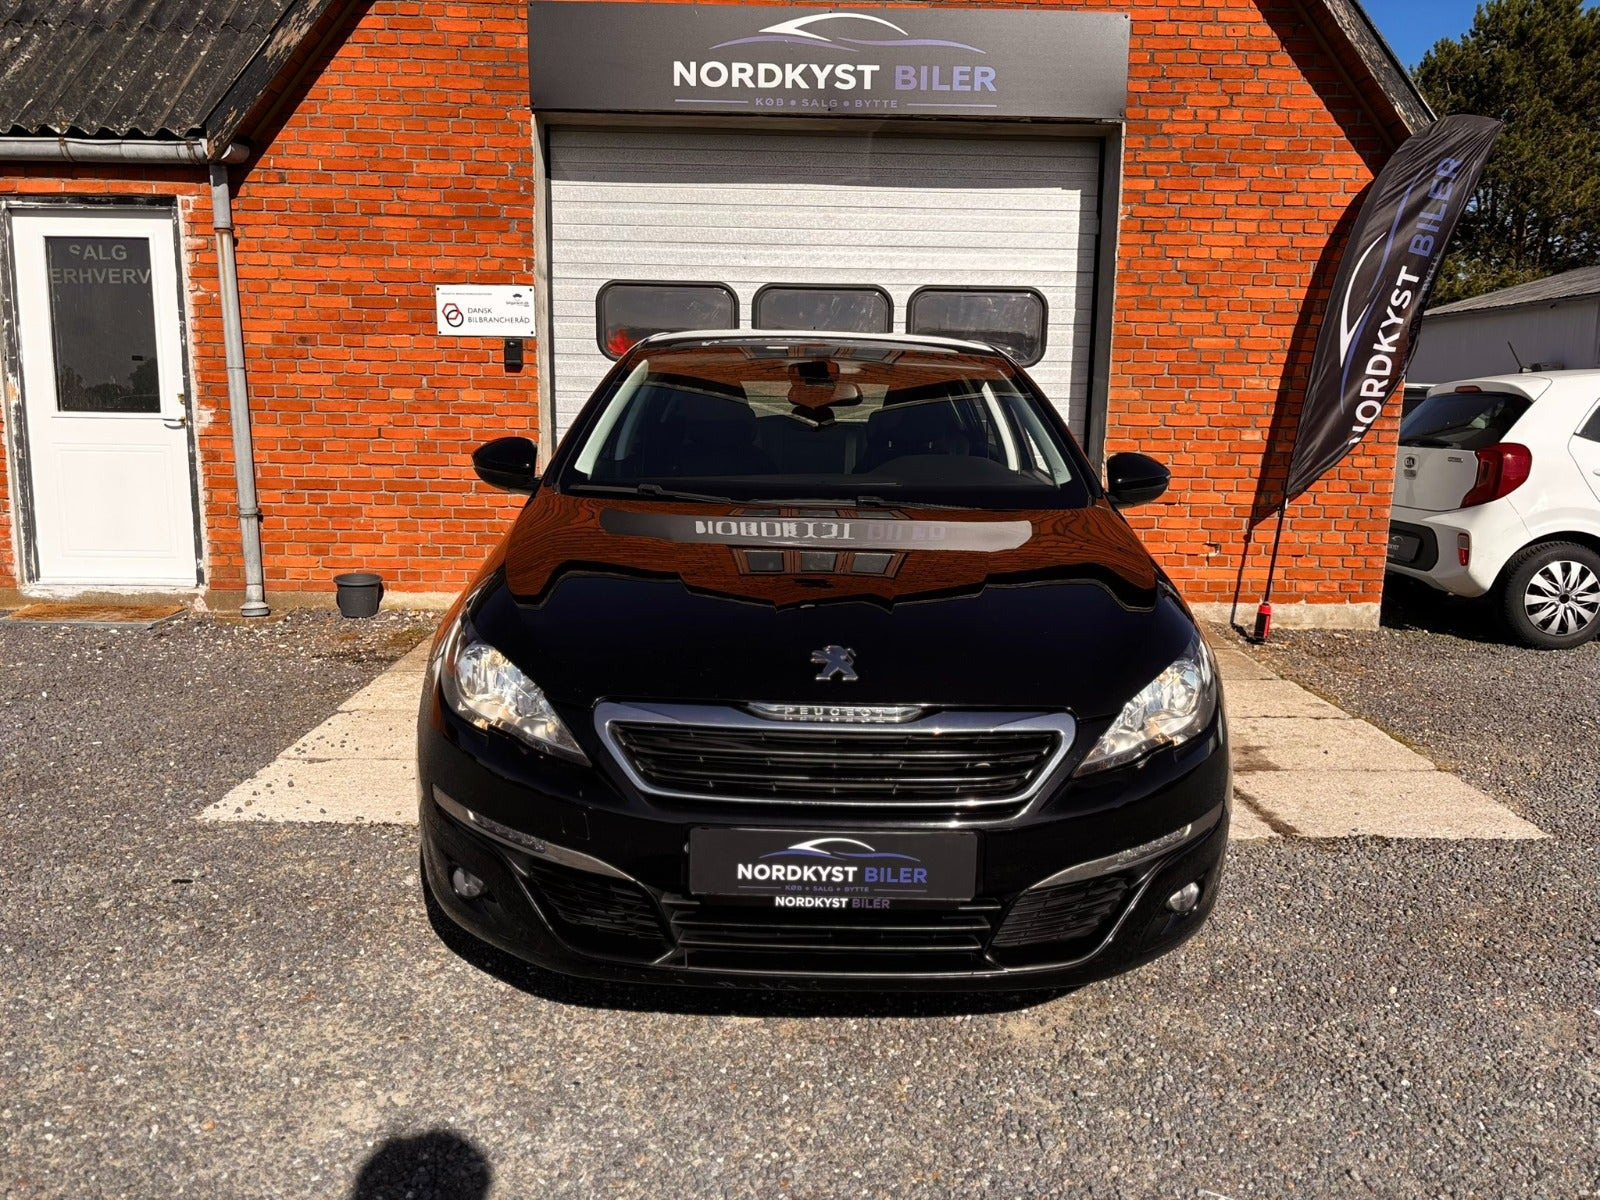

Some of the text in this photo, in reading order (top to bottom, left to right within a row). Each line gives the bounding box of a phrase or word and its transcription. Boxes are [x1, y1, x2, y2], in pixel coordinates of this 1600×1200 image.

[673, 60, 997, 92] NORDKYST BILER
[755, 97, 898, 109] KØB SALG BYTTE
[1408, 157, 1462, 257] BILER
[68, 244, 128, 261] SALG
[51, 268, 151, 285] ERHVERV
[467, 316, 530, 324] BILBRANCHERÅD
[737, 863, 928, 884] NORDKYST BILER
[774, 896, 891, 909] NORDKYST BILER
